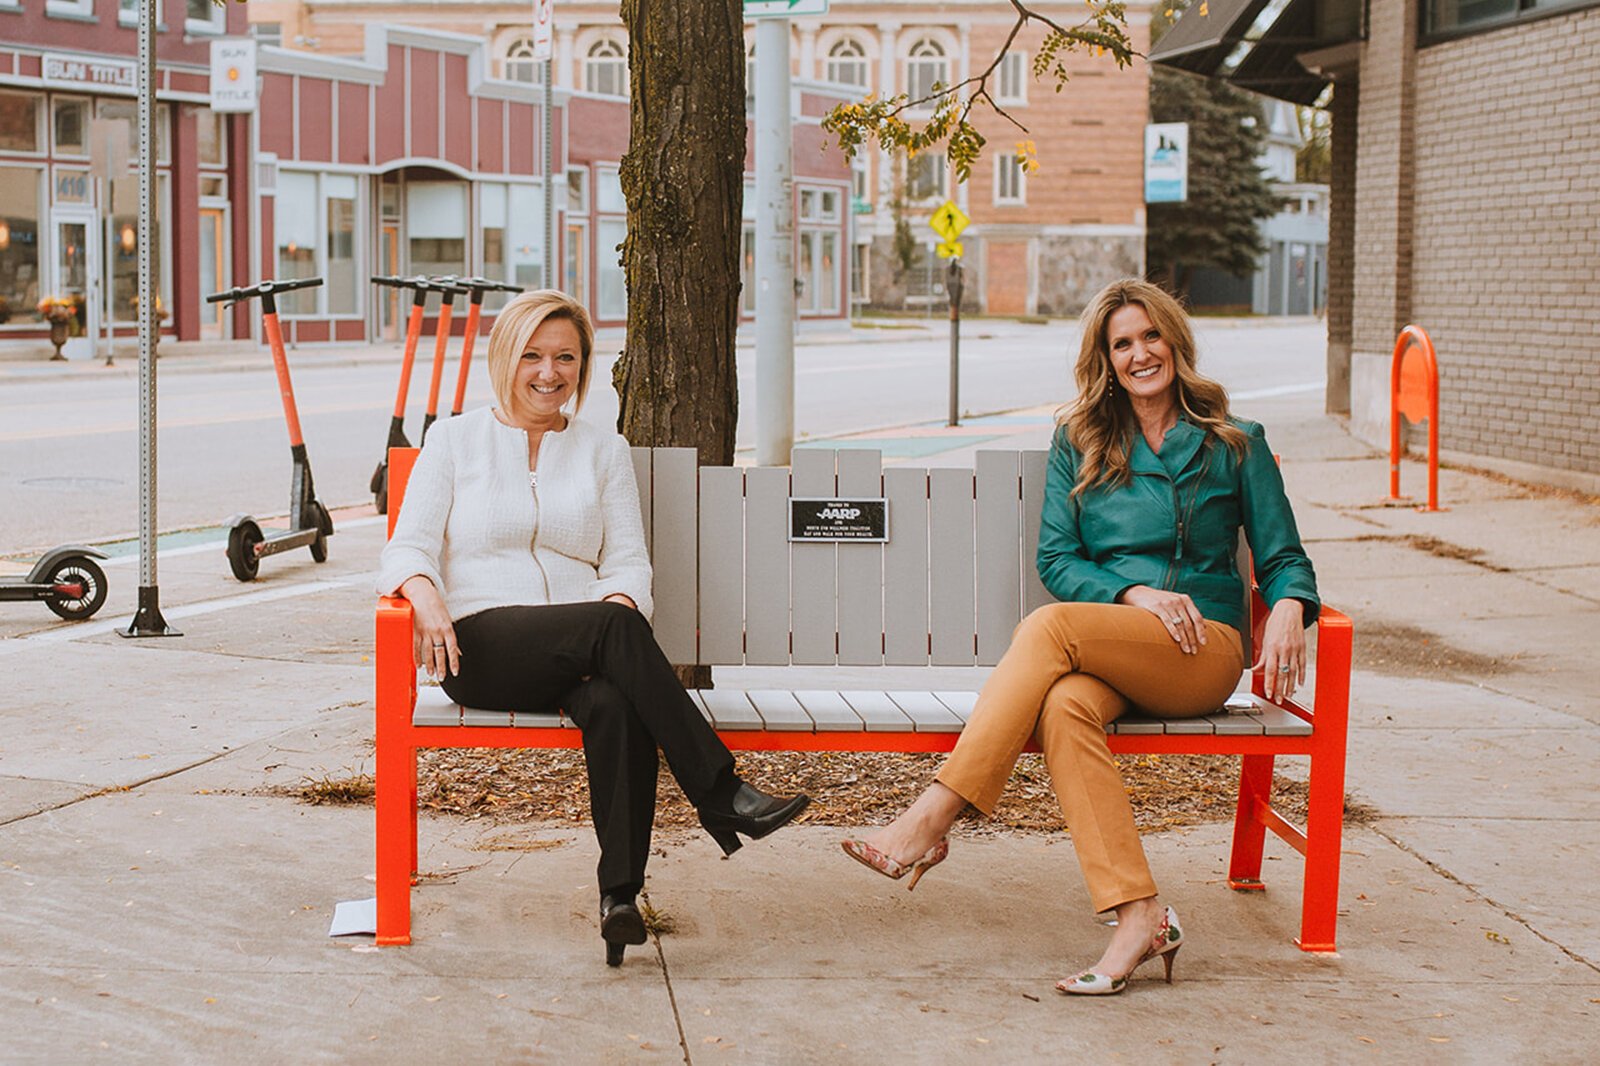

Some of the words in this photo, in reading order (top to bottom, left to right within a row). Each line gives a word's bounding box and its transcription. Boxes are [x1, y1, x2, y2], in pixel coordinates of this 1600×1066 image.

[49, 60, 85, 80] SUN
[89, 64, 133, 86] TITLE
[216, 90, 250, 100] TITLE
[816, 508, 861, 520] AARP
